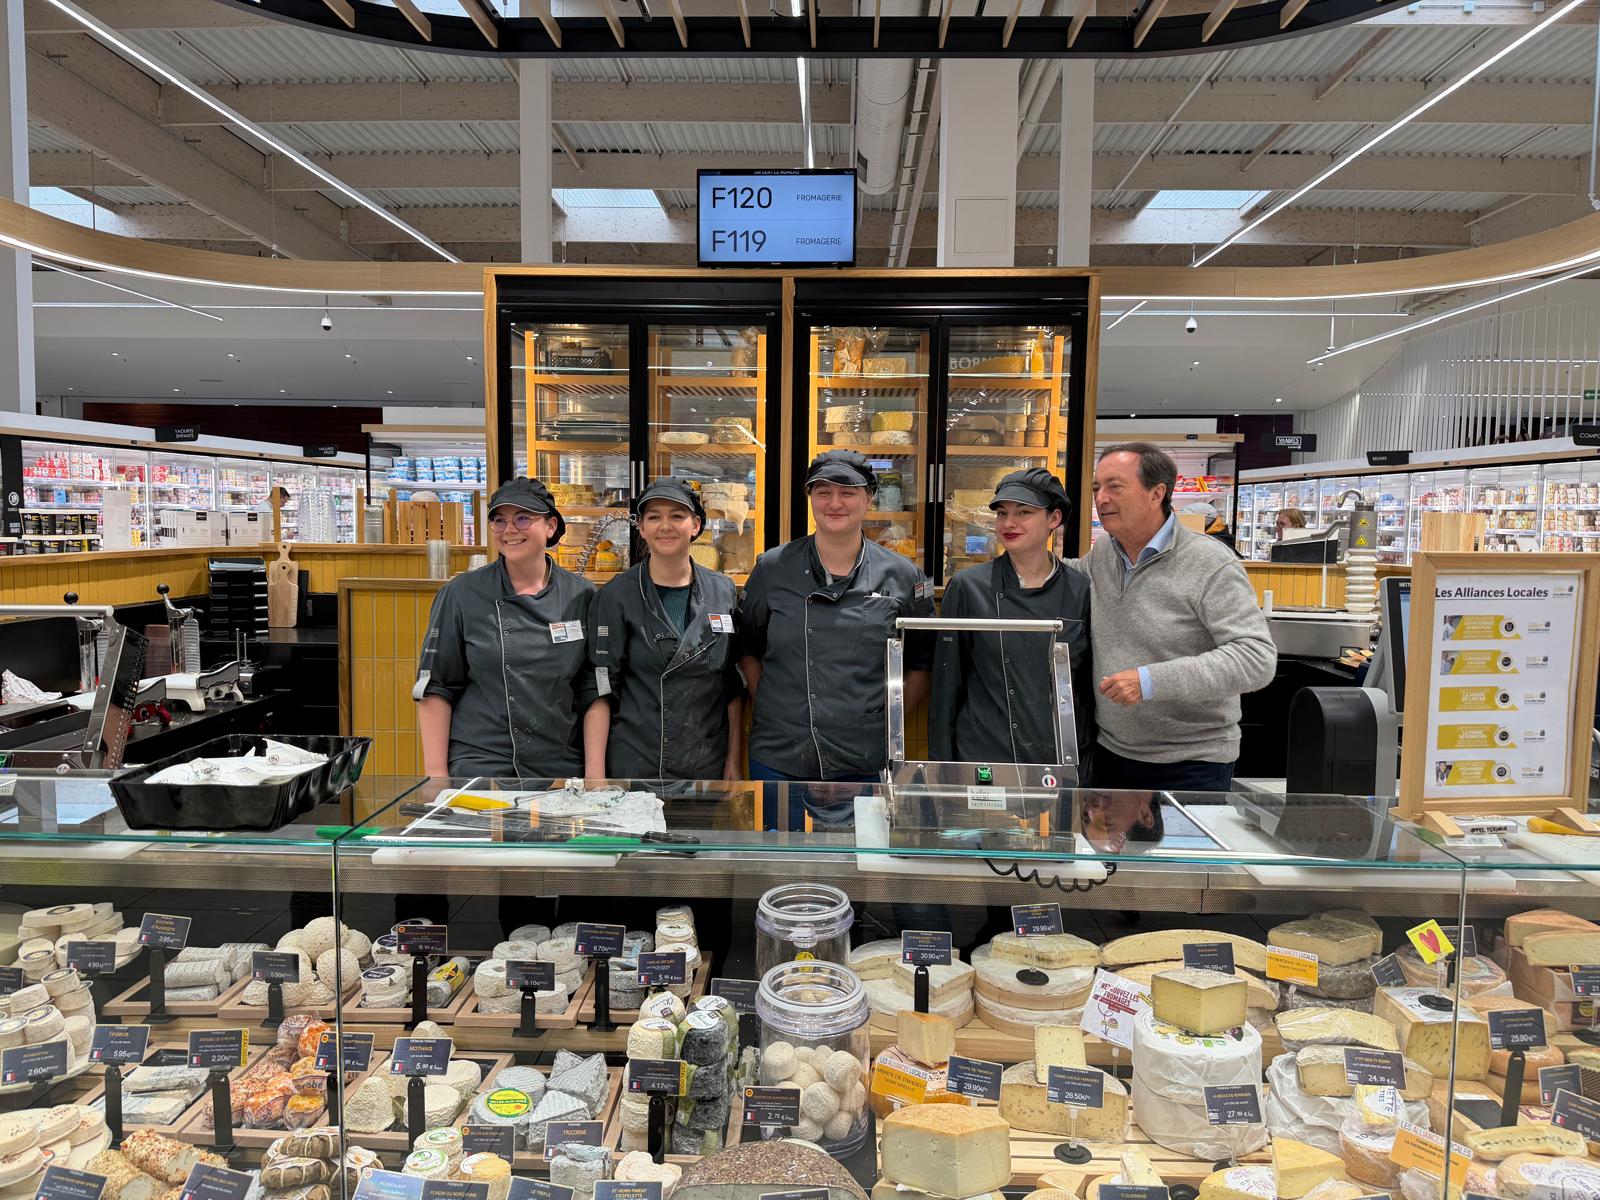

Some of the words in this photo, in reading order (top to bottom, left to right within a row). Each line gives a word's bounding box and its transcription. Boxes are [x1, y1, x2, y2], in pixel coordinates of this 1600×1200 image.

[712, 187, 772, 209] F120
[796, 194, 843, 202] FROMAGERIE
[712, 230, 767, 253] F119
[796, 238, 842, 246] FROMAGERIE
[1435, 587, 1452, 598] Les
[1455, 587, 1505, 598] Alliances
[1507, 586, 1549, 598] Locales
[1103, 990, 1131, 1007] FROMAGES
[1130, 993, 1139, 1003] LES
[1400, 1121, 1412, 1130] LES
[1412, 1125, 1444, 1144] ALLIANCES
[1449, 1142, 1472, 1158] CALES
